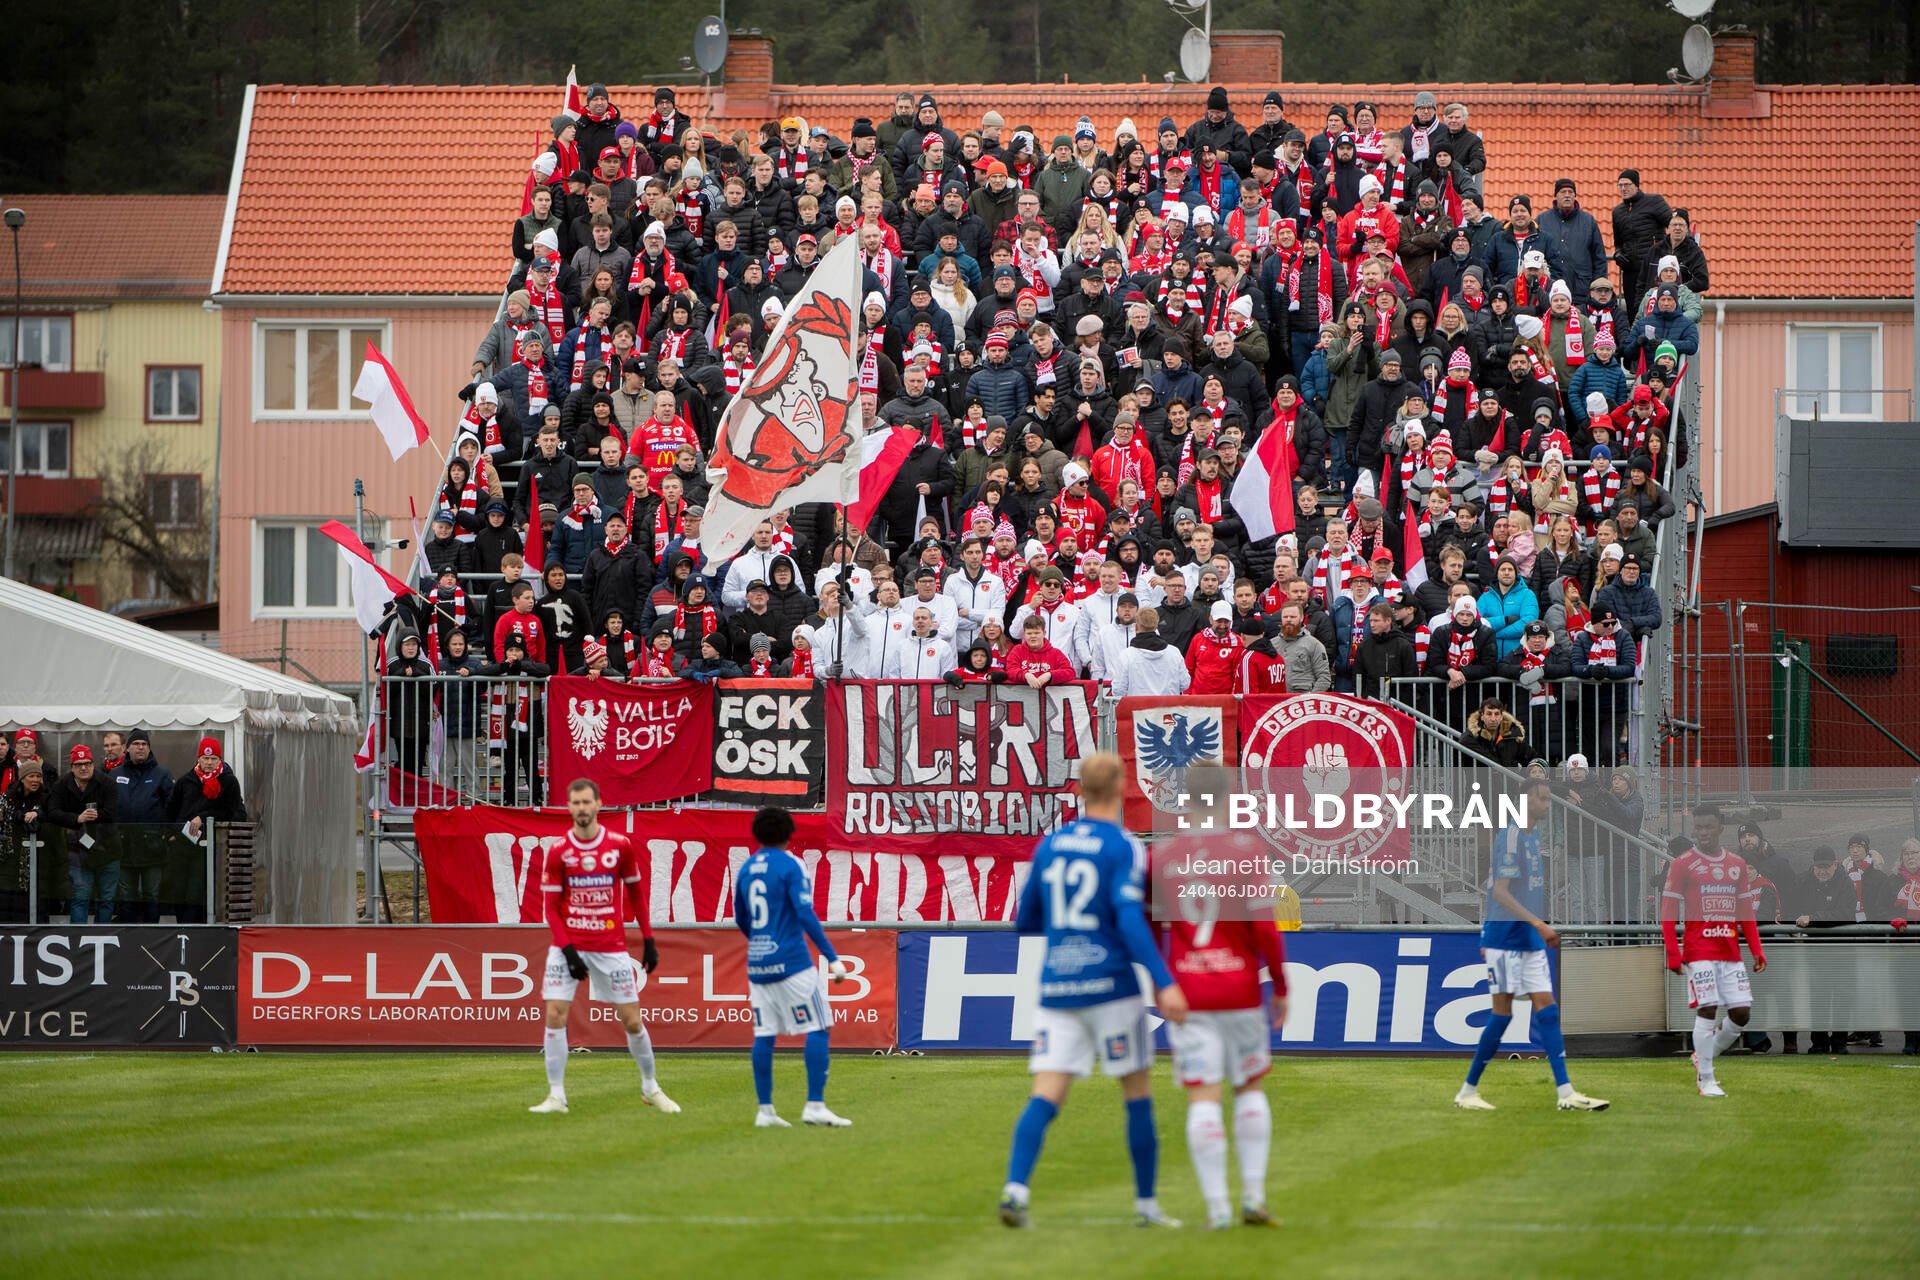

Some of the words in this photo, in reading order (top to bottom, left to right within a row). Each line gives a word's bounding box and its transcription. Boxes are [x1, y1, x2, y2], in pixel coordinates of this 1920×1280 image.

[614, 697, 693, 723] VALLA
[719, 694, 812, 730] FCK
[1263, 699, 1388, 741] DEGERFORS
[715, 729, 812, 774] ÖSK
[844, 683, 1112, 788] ULTRA
[843, 790, 1086, 836] ROSSOBIANC
[748, 879, 769, 929] 6
[1042, 857, 1099, 930] 12
[1179, 880, 1220, 948] 9
[0, 935, 120, 985] IST
[252, 951, 534, 1000] D-LAB
[921, 936, 1532, 1043] Hmia
[252, 1006, 362, 1021] DEGERFORS
[369, 1006, 511, 1021] LABORATORIUM
[517, 1007, 541, 1021] AB
[589, 1007, 699, 1022] DERFORS
[854, 1008, 879, 1022] AB
